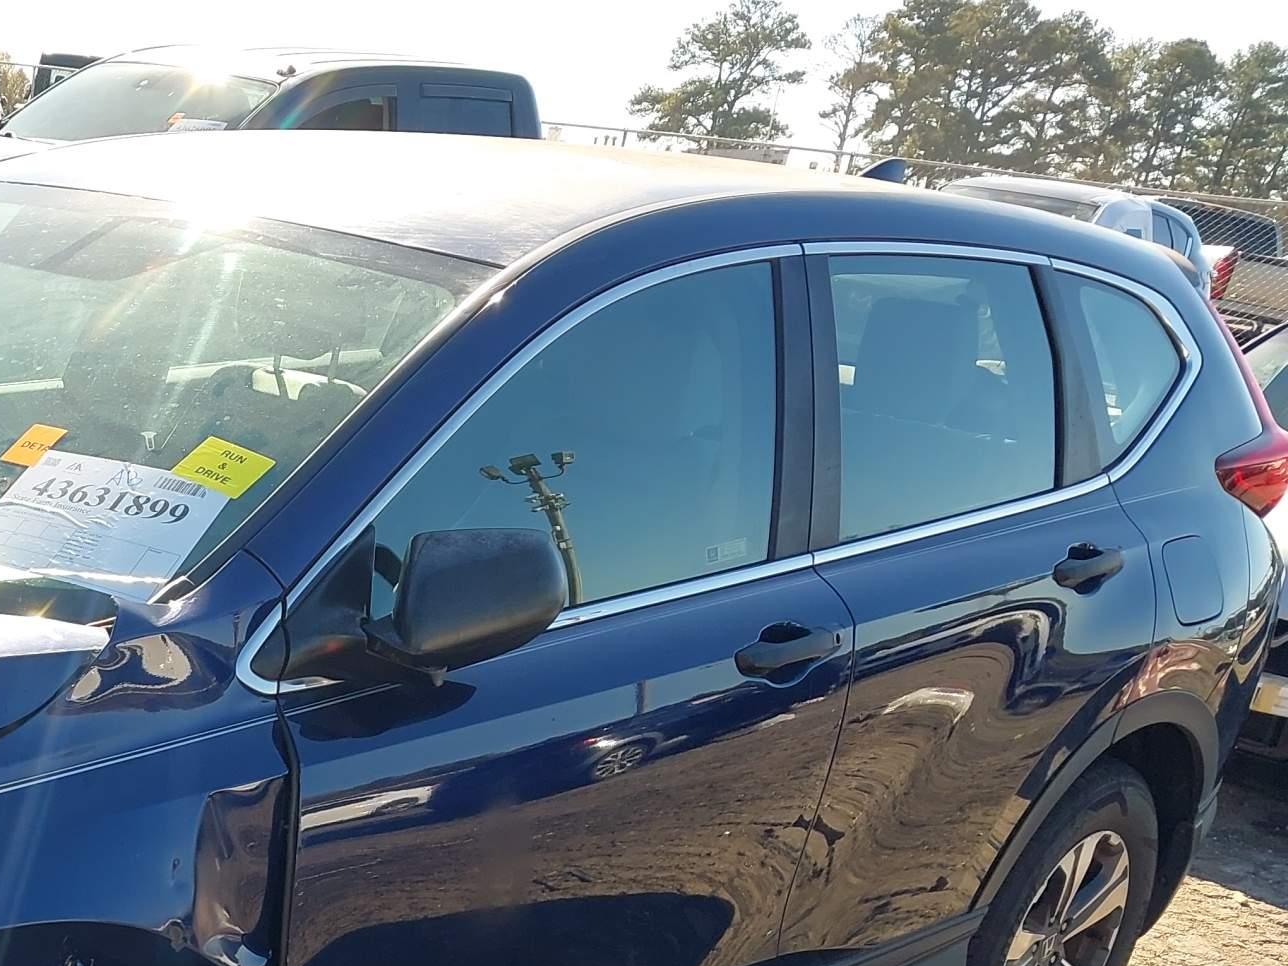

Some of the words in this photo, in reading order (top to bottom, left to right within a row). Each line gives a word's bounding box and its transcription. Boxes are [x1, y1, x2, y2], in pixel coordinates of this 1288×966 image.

[220, 450, 248, 464] RUN
[217, 462, 228, 471] &
[195, 466, 232, 485] DRIVE
[32, 477, 190, 524] 43631899
[54, 501, 91, 514] Insurance
